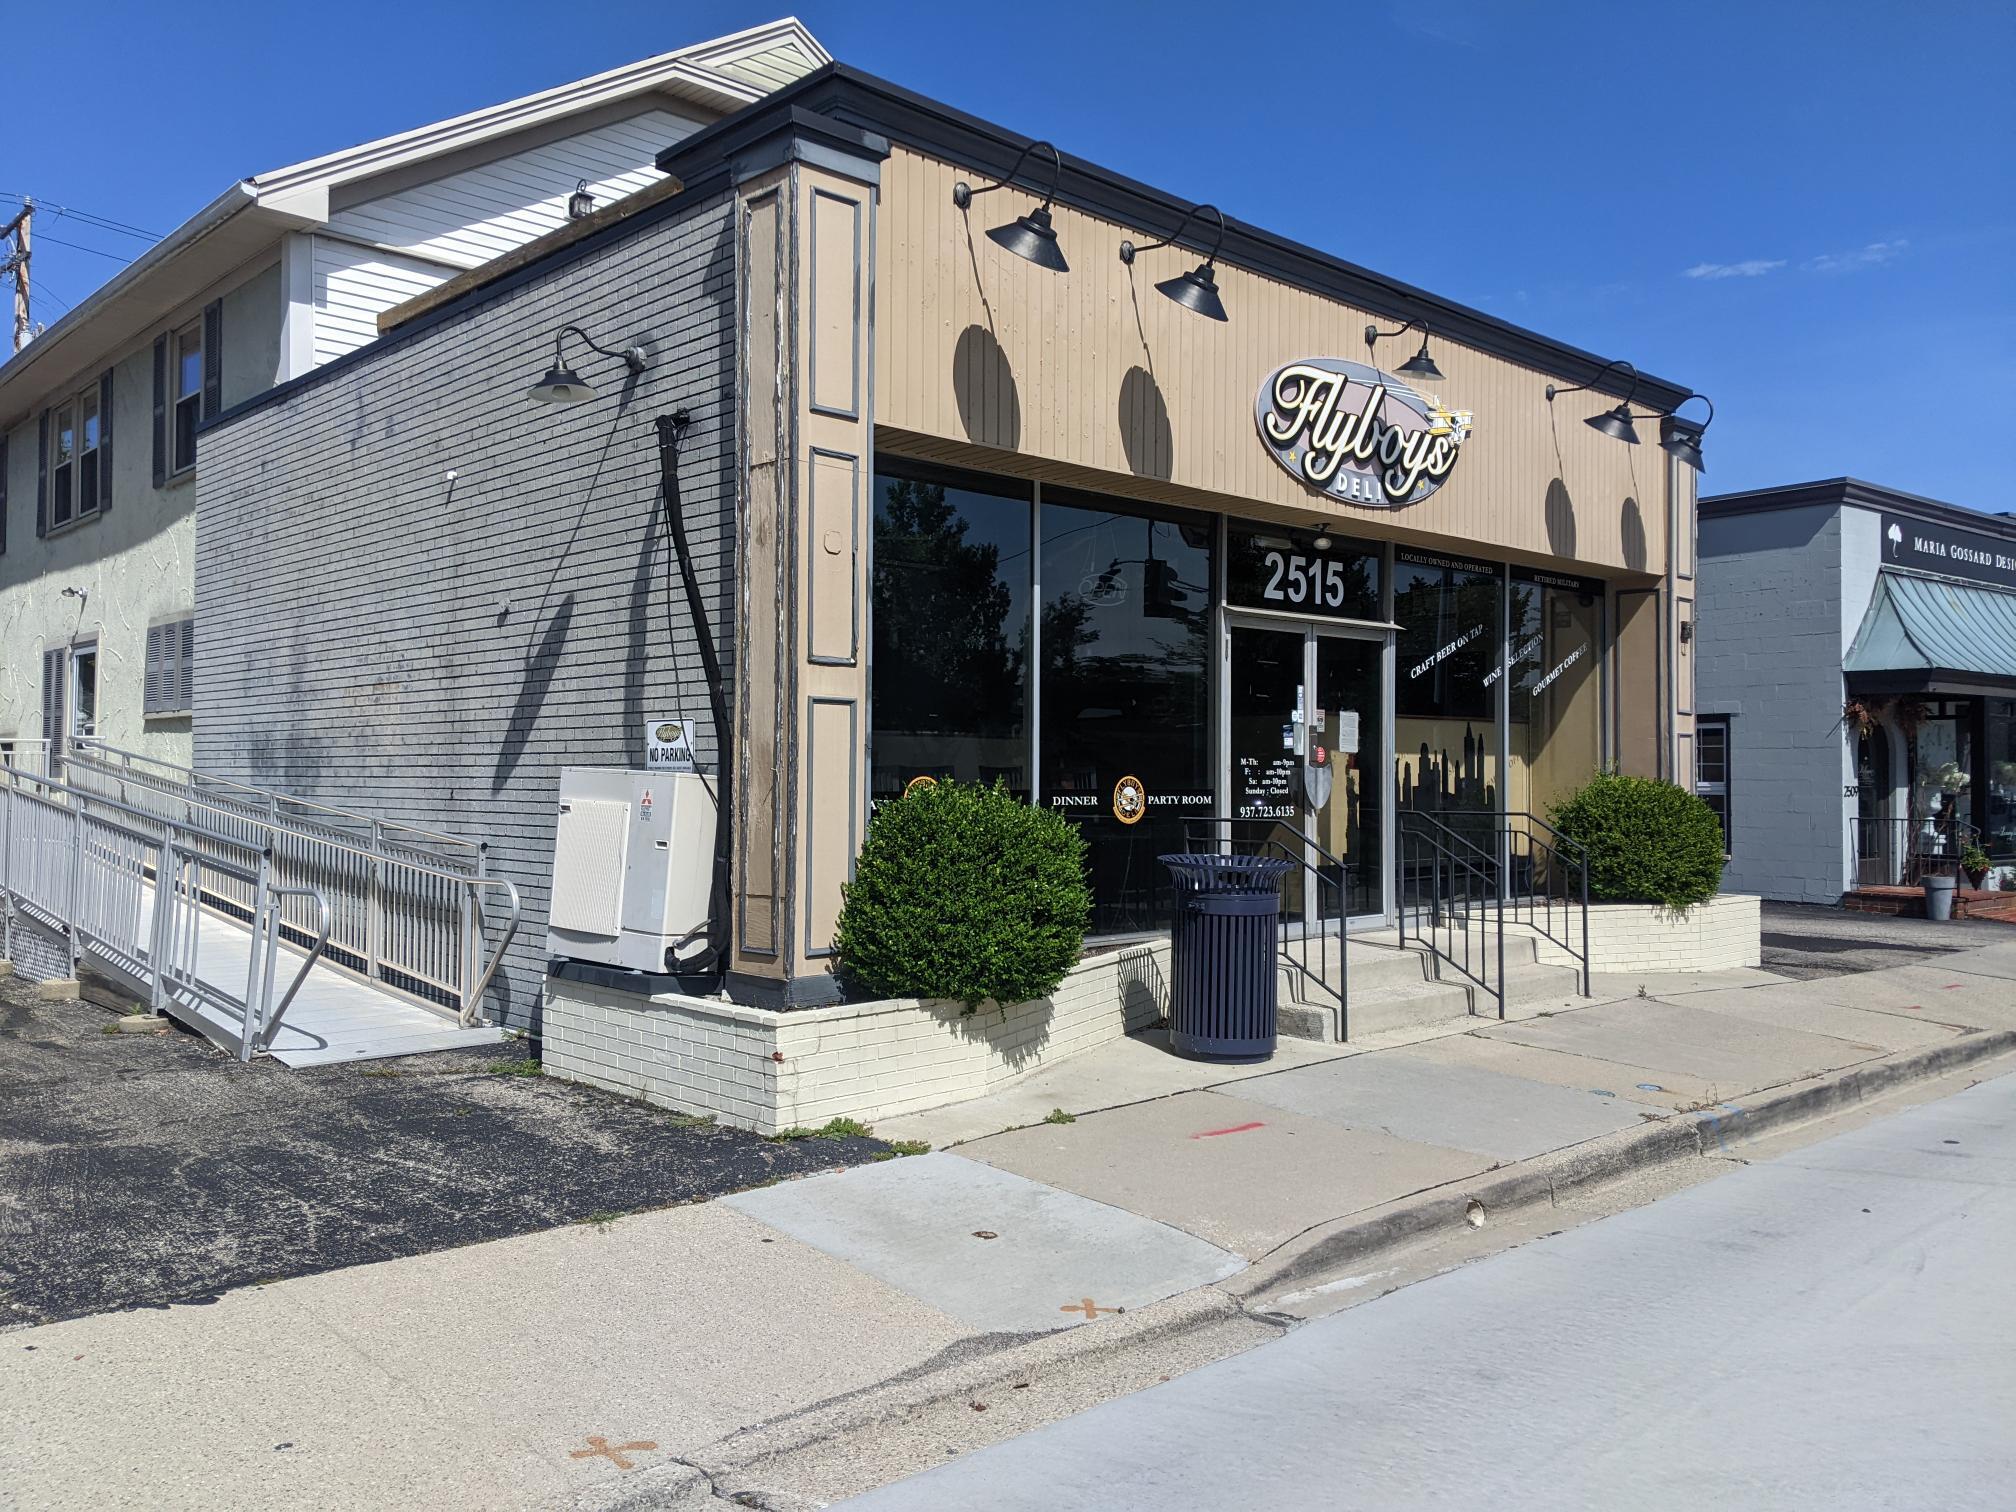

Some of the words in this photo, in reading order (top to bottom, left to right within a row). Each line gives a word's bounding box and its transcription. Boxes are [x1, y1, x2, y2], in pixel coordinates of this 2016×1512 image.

[1264, 364, 1458, 498] Flyboys
[1337, 474, 1383, 501] DELI
[1401, 552, 1428, 564] LOCALLY
[1428, 557, 1450, 568] OWNED
[1450, 561, 1464, 570] AND
[1464, 563, 1493, 575] OPERATED
[1914, 536, 1947, 557] MARIA
[1950, 545, 1992, 566] GOSSARD
[1996, 554, 2016, 571] DESI
[1079, 580, 1128, 600] OPEN
[1263, 551, 1345, 608] 2515
[1534, 574, 1557, 585] RETIRED
[1557, 578, 1580, 588] MILITARY
[1410, 655, 1435, 679] CRAFT
[1436, 642, 1457, 663] BEER
[1457, 633, 1469, 648] ON
[1470, 624, 1483, 640] TAP
[1482, 666, 1503, 688] WINE
[1507, 632, 1544, 669] SELECTION
[1532, 663, 1564, 697] GOURMET
[1564, 642, 1588, 669] COFFEE
[649, 747, 659, 762] NO
[660, 747, 692, 762] PARKING
[1052, 796, 1099, 806] DINNER
[1147, 795, 1180, 805] PARTY
[1182, 795, 1213, 805] ROOM
[1245, 786, 1266, 797] Sunday
[1270, 786, 1289, 795] Closed
[1240, 805, 1295, 818] 937.723.6135
